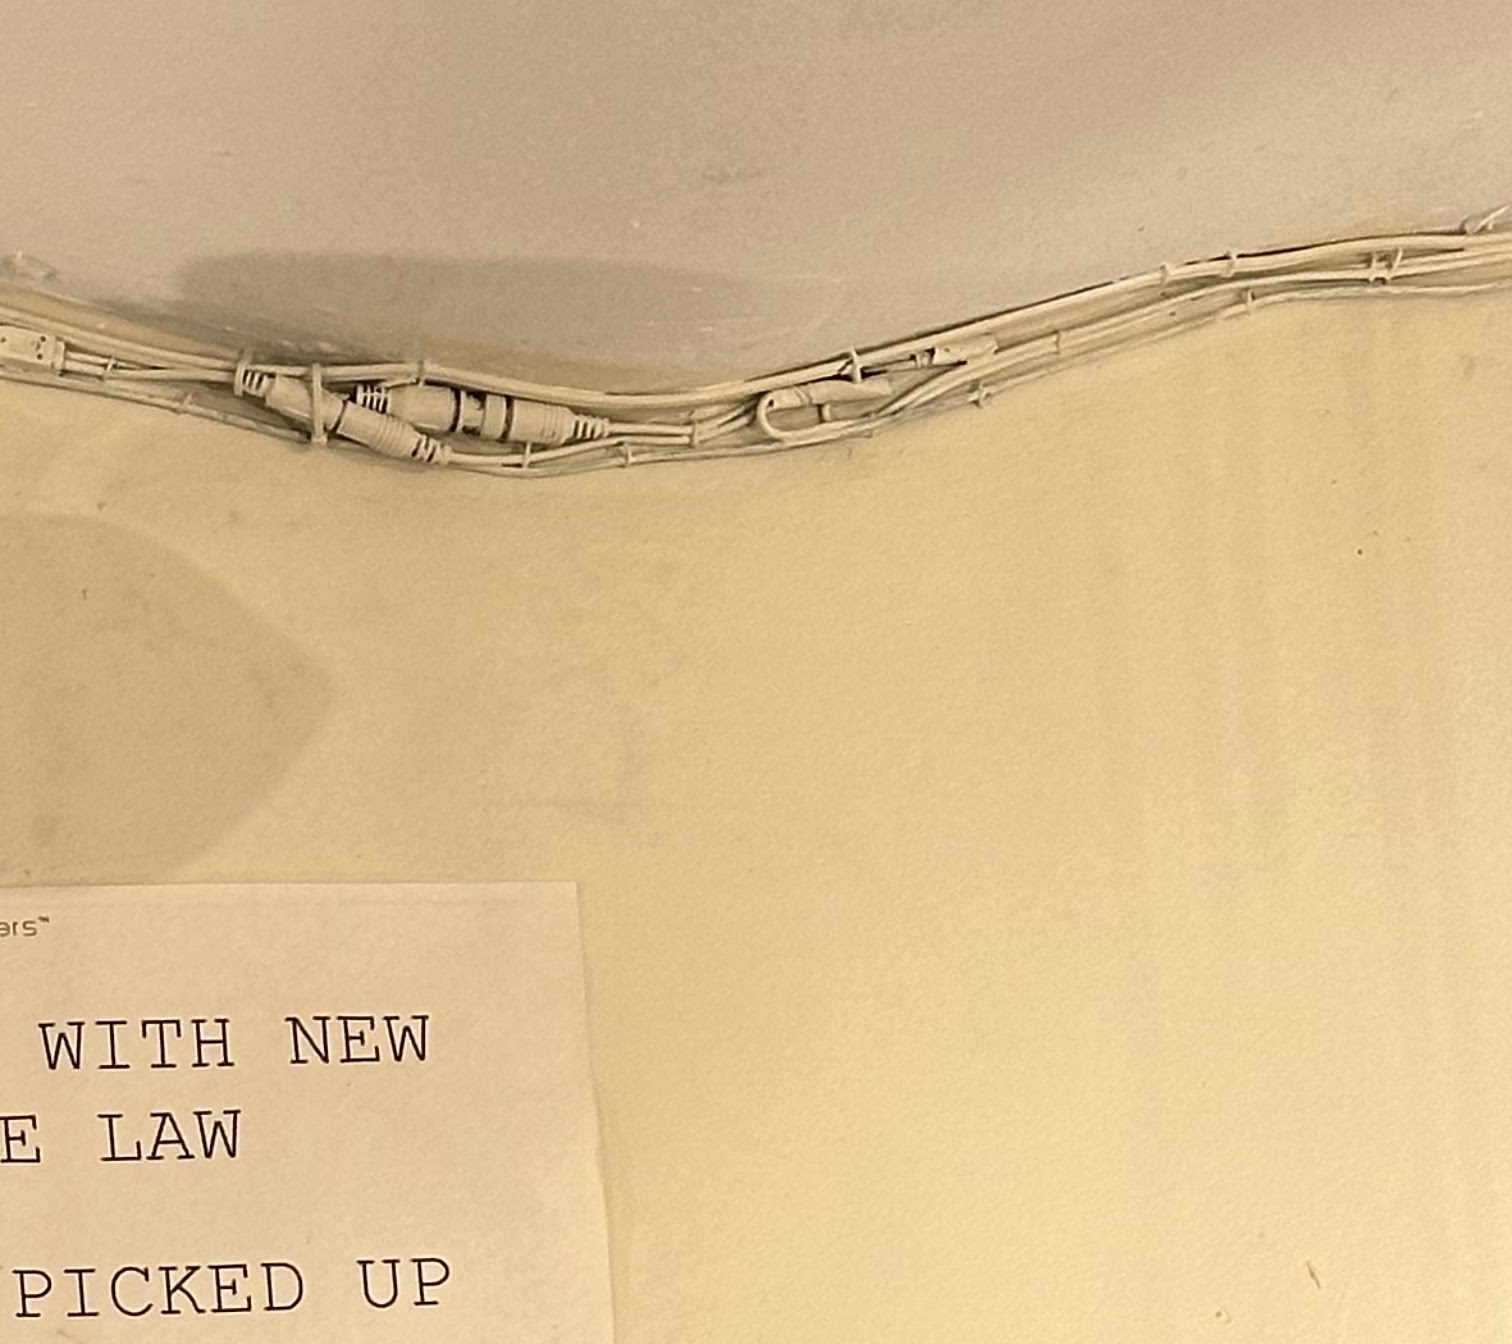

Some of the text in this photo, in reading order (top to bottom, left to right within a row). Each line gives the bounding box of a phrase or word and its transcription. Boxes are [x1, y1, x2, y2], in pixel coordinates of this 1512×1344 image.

[38, 1018, 236, 1071] WITH
[284, 1015, 431, 1065] NEW
[97, 1109, 242, 1162] LAW
[13, 1262, 304, 1318] PICKED
[356, 1257, 452, 1309] UP
